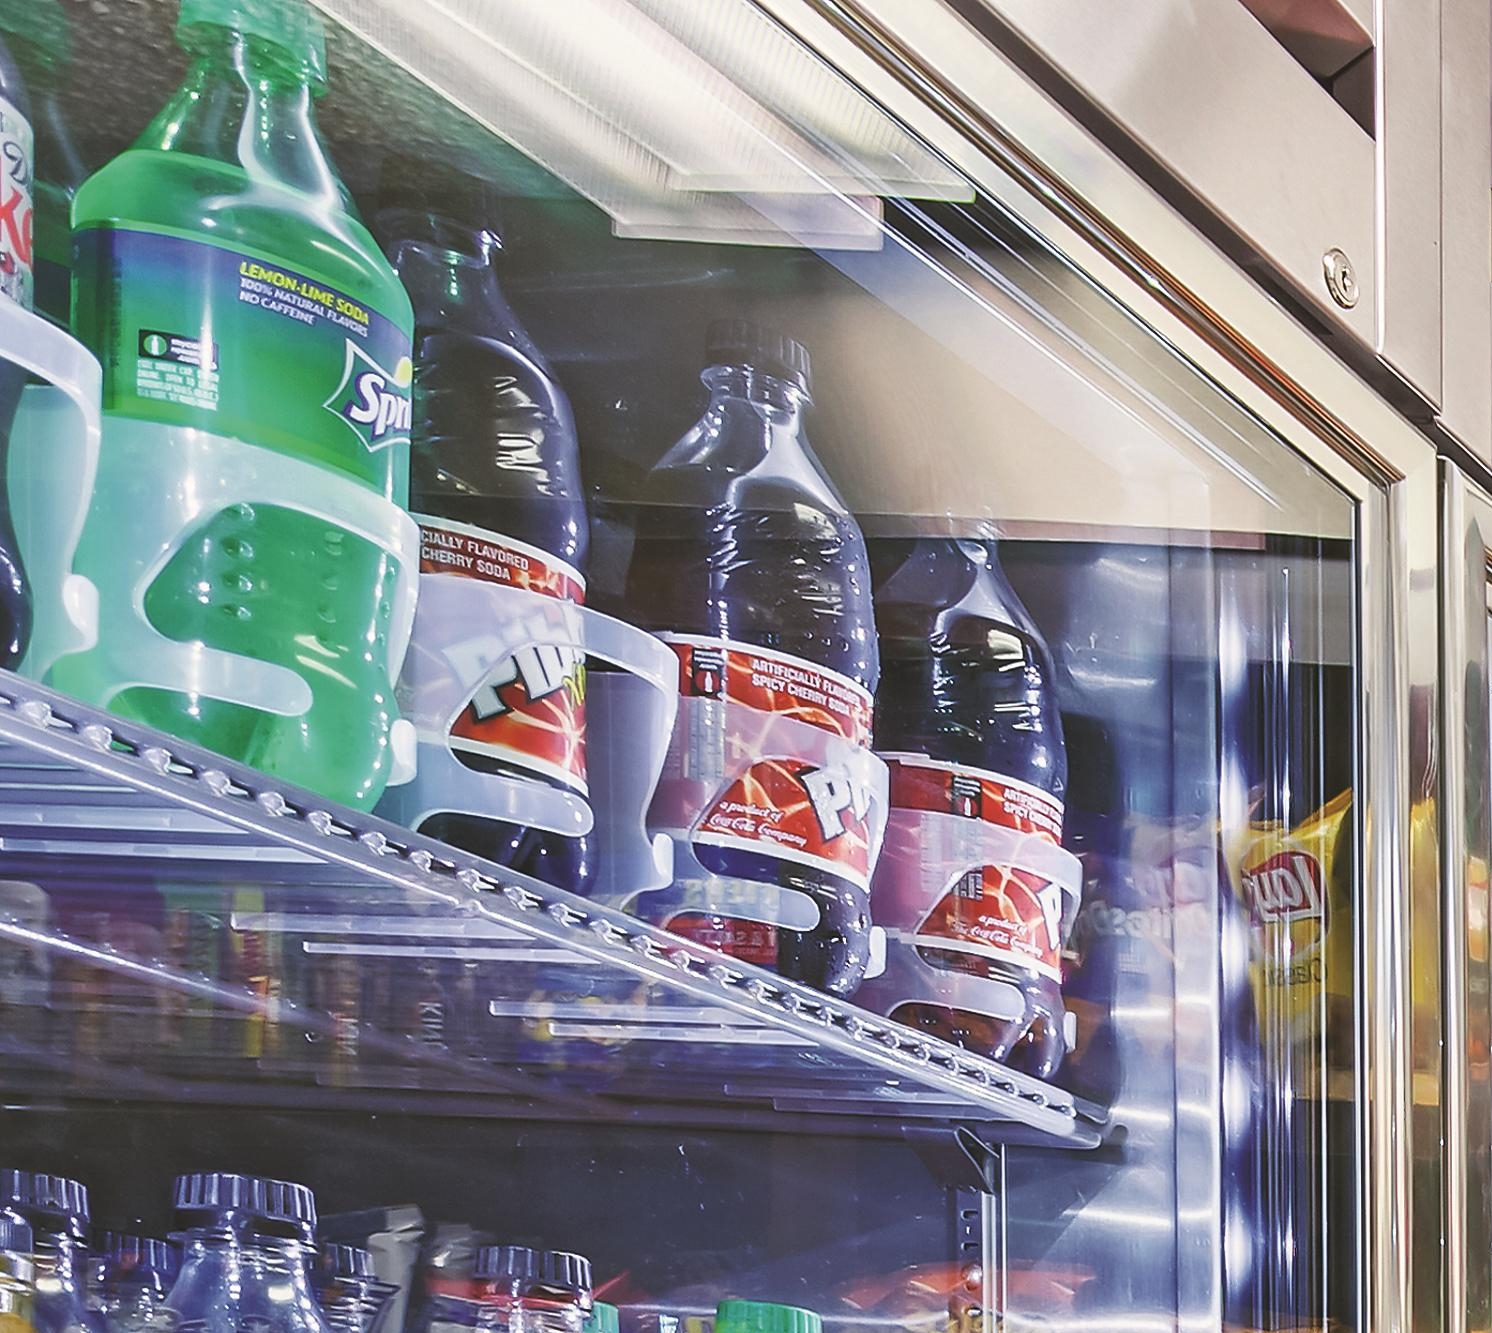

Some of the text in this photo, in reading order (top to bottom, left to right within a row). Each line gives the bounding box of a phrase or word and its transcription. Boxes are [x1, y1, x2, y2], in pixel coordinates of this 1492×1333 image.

[240, 277, 368, 337] 100% NATURAL FLAVORS
[240, 291, 316, 325] NO CAFFEINE
[337, 298, 369, 324] SODA
[422, 548, 511, 580] CHERRY SODA
